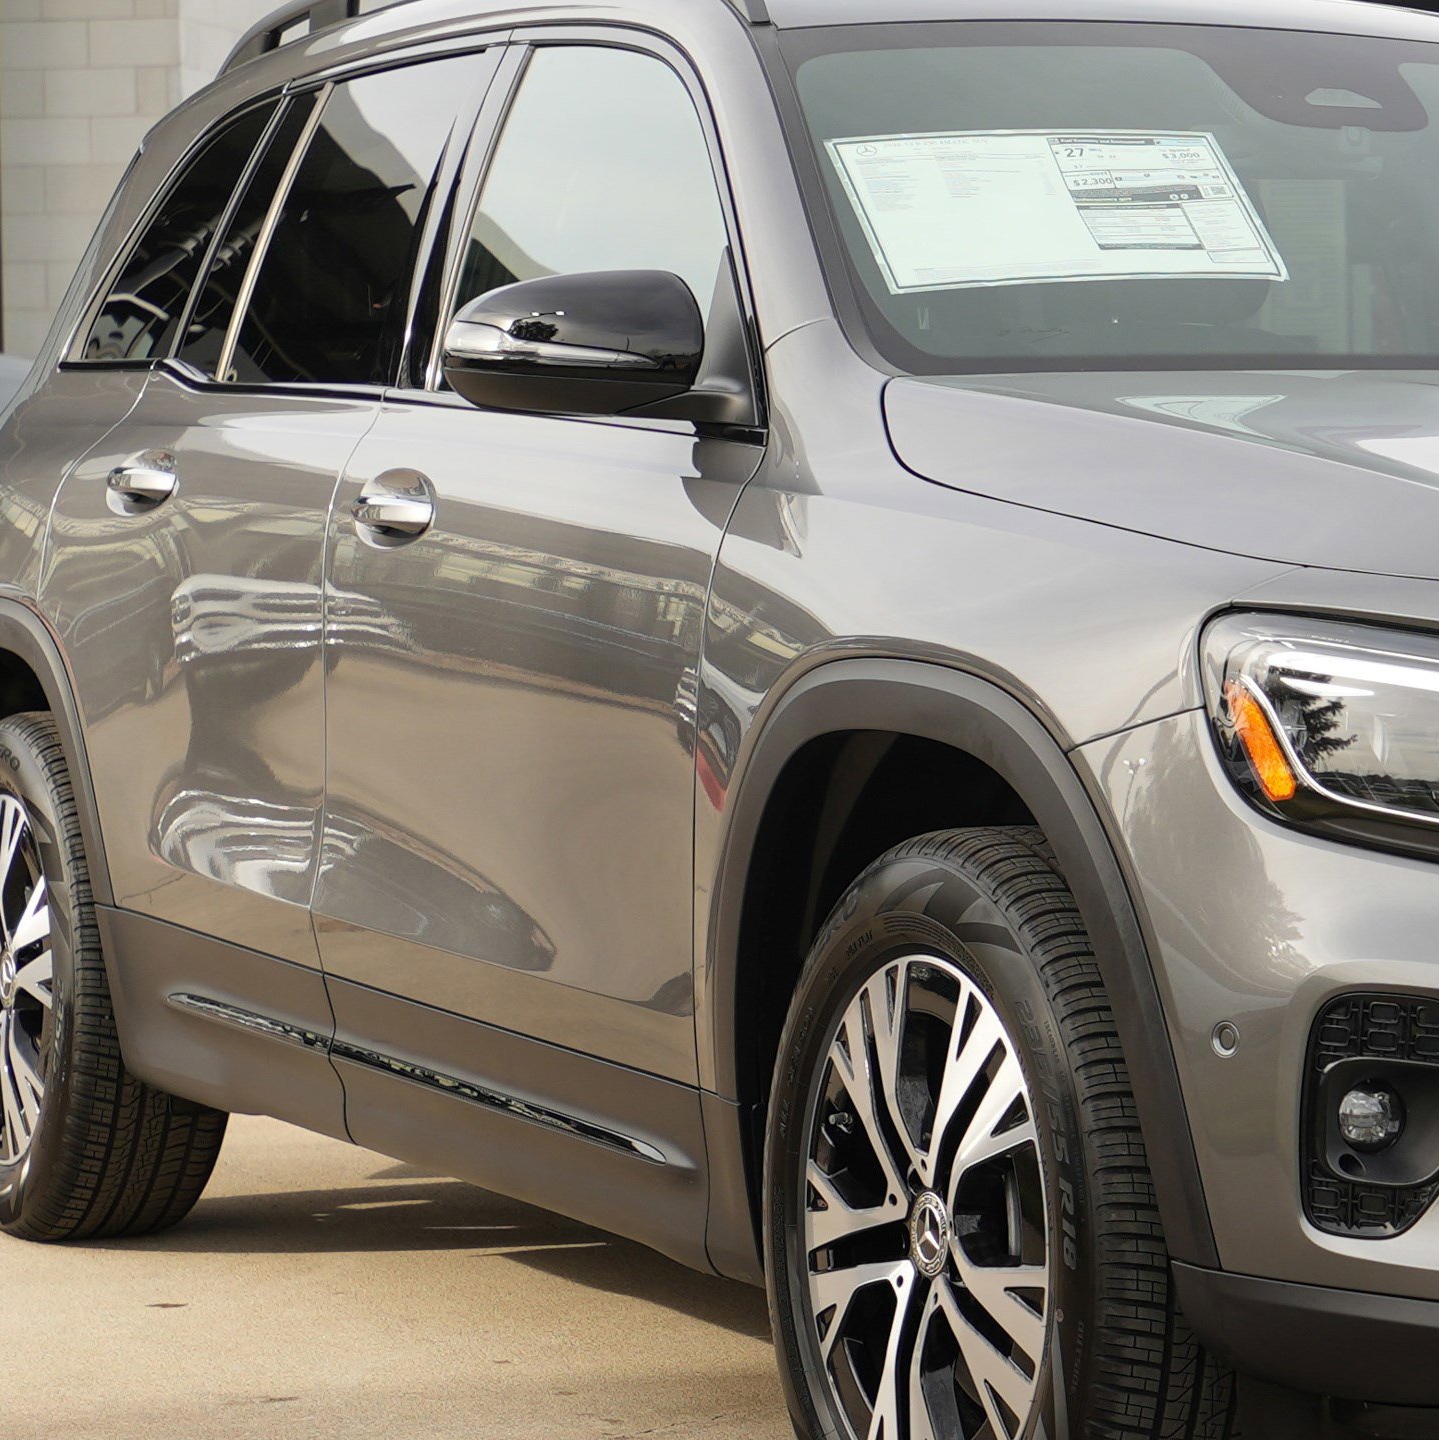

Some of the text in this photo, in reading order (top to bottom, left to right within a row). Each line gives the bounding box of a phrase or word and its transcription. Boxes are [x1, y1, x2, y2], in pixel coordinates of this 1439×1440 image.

[1064, 147, 1084, 158] 27
[1072, 177, 1113, 187] $2,300
[1015, 998, 1071, 1166] 235/55
[1058, 1175, 1078, 1272] R18
